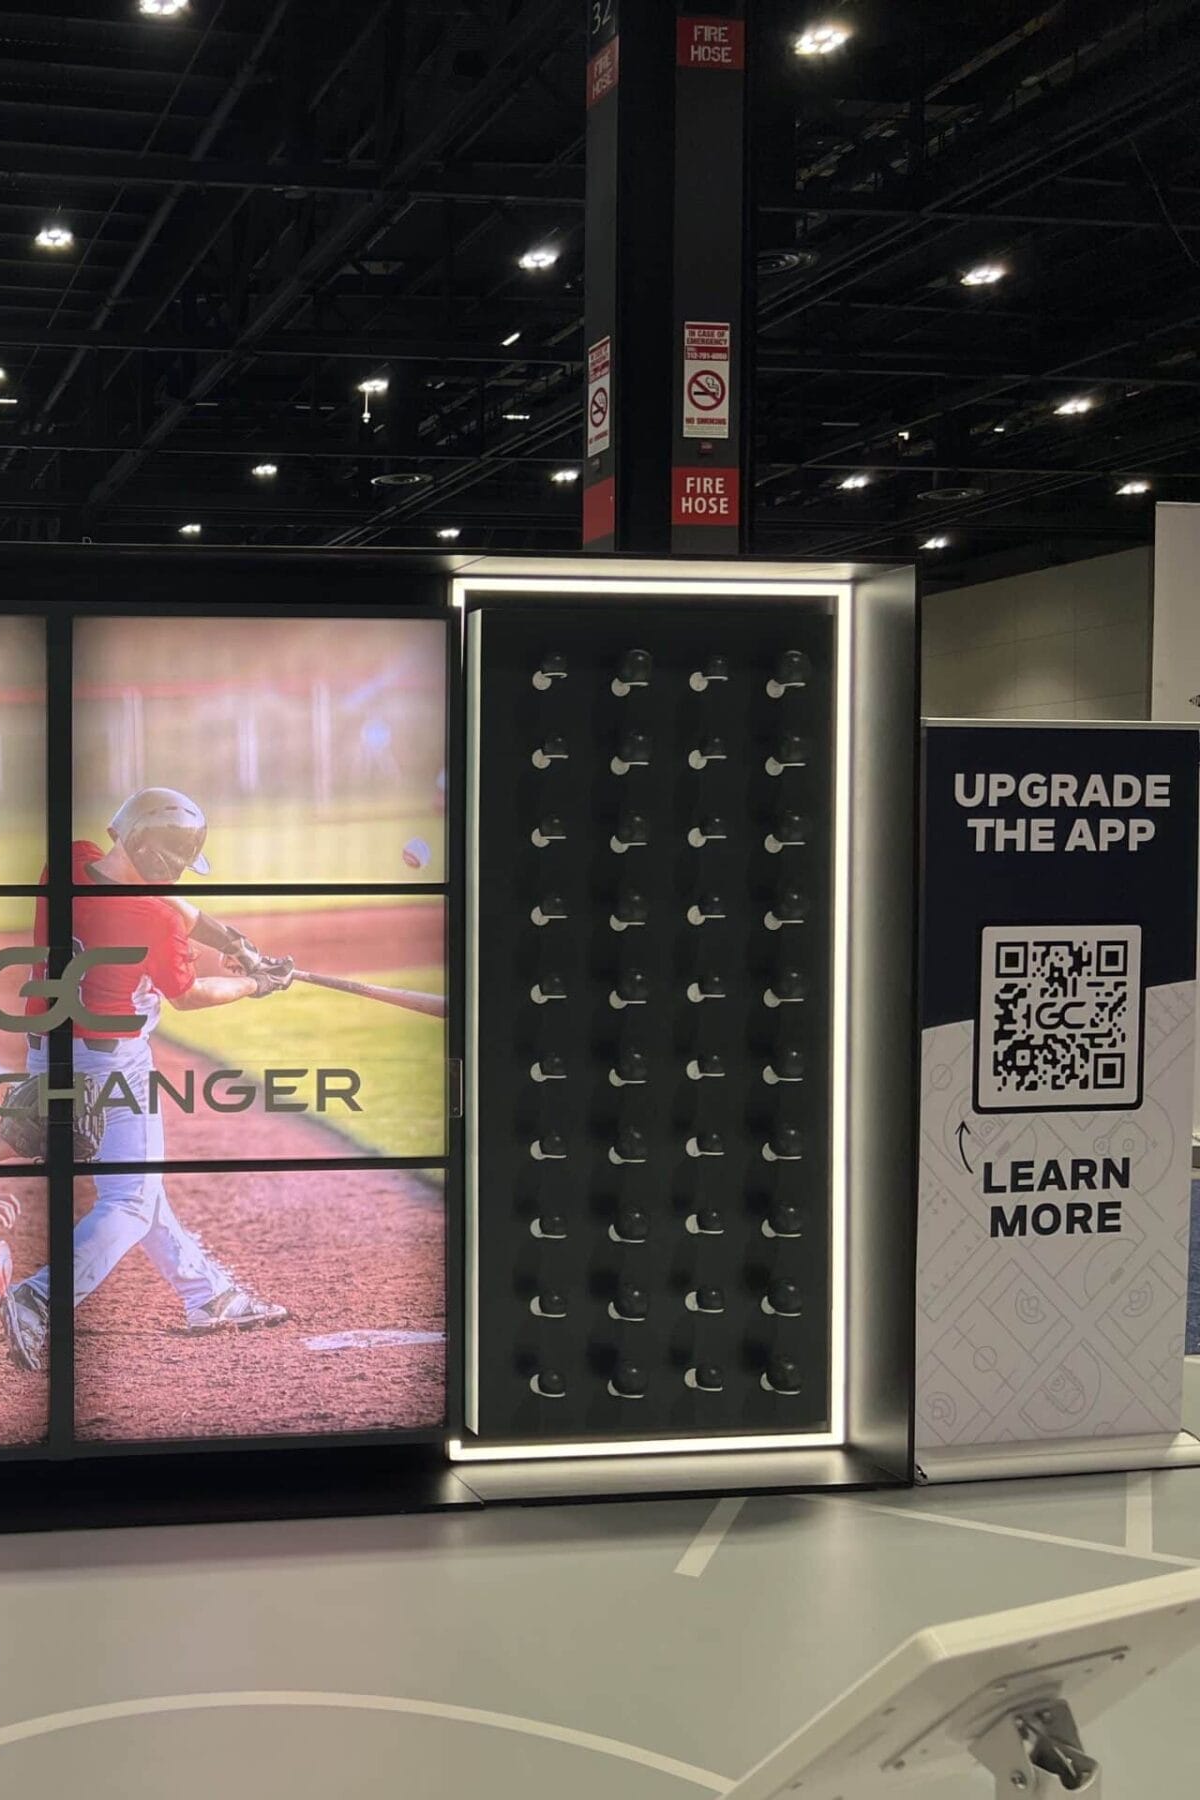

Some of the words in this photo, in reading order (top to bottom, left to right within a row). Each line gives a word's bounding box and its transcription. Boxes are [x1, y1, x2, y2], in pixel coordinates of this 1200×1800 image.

[694, 25, 729, 42] FIRE
[691, 45, 732, 63] HOSE
[686, 417, 695, 425] NO
[696, 417, 727, 426] SMOKING
[686, 477, 725, 494] FIRE
[681, 497, 729, 514] HOSE
[954, 773, 1171, 808] UPGRADE
[967, 818, 1056, 851] THE
[1064, 818, 1156, 851] APP
[1035, 1001, 1086, 1030] GC
[983, 1157, 1131, 1194] LEARN
[990, 1201, 1122, 1238] MORE
